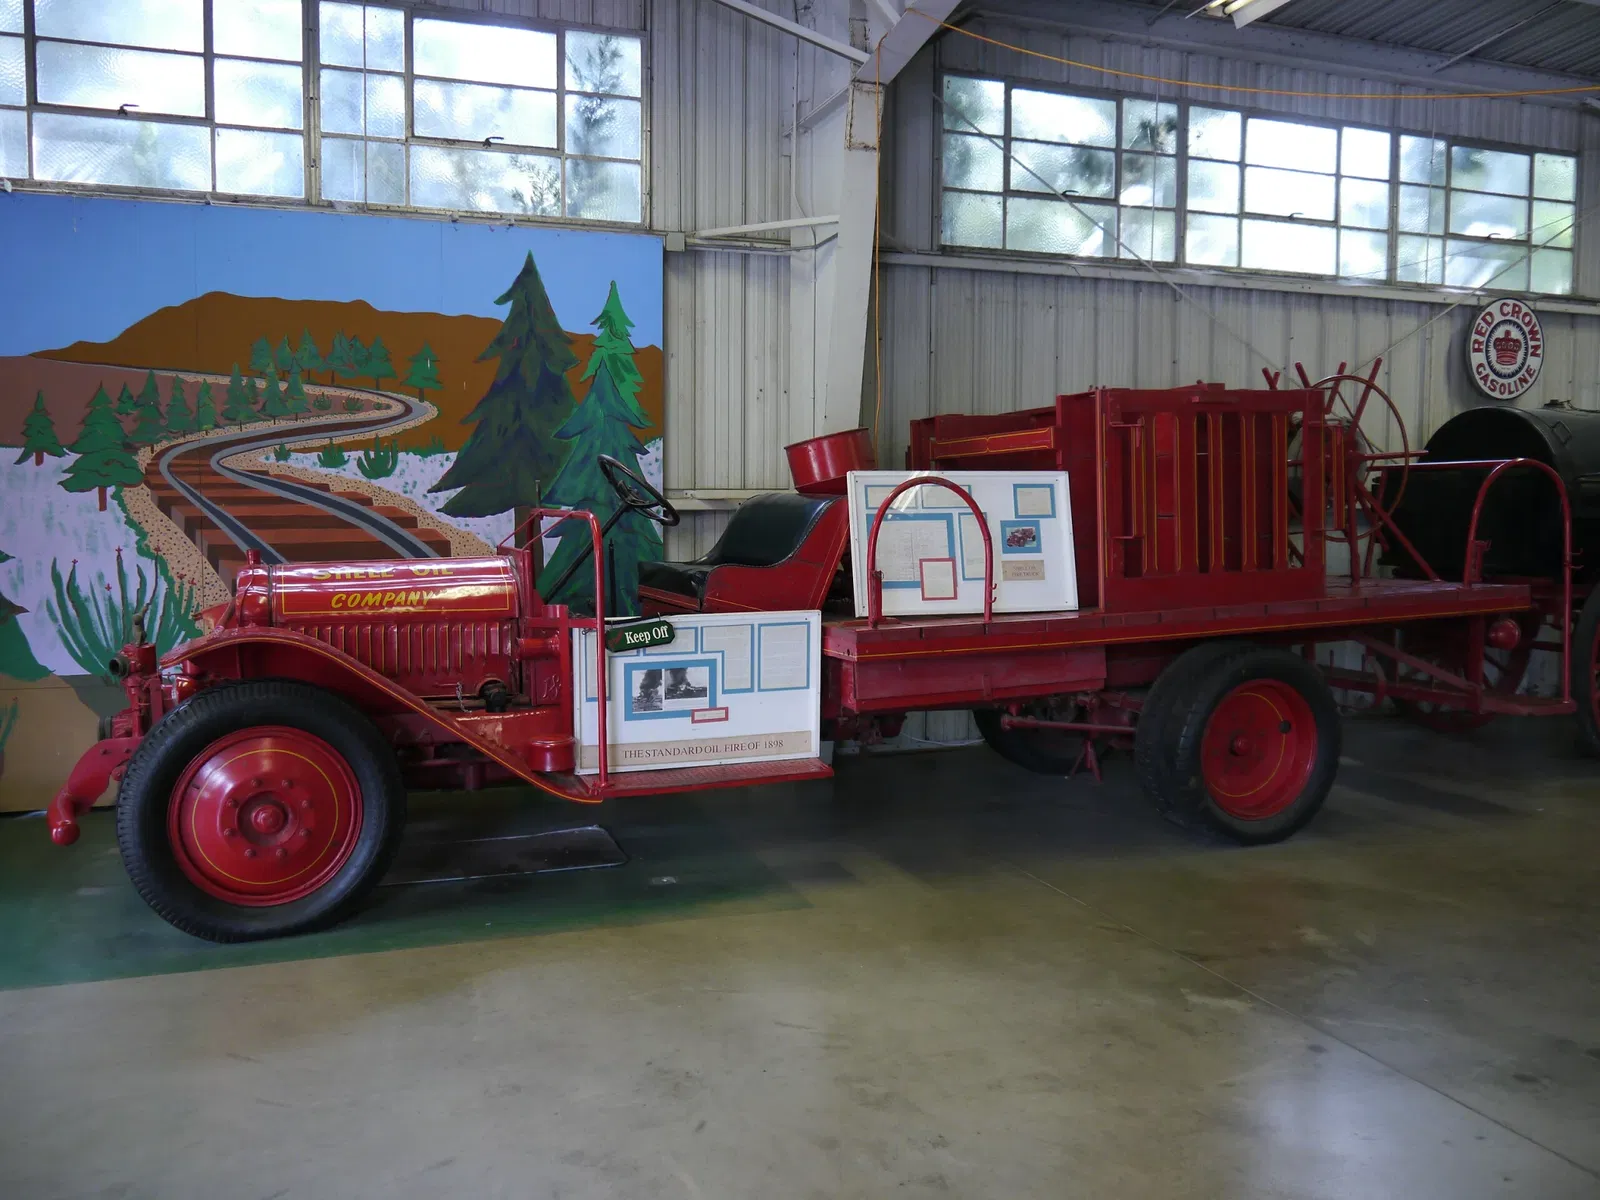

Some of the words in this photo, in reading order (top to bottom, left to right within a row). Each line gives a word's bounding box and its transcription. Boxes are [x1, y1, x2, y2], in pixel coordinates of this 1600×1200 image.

[1472, 311, 1495, 353] RED
[1500, 302, 1542, 358] CROWN
[1475, 363, 1537, 396] GASOLINE
[331, 590, 434, 609] COMPANY
[624, 631, 651, 644] Keep
[652, 625, 669, 639] Off
[623, 750, 644, 759] THE
[645, 746, 703, 758] STANDARD
[704, 744, 721, 754] OIL
[724, 743, 746, 752] FIRE
[746, 741, 761, 750] OF
[764, 740, 784, 749] 1898
